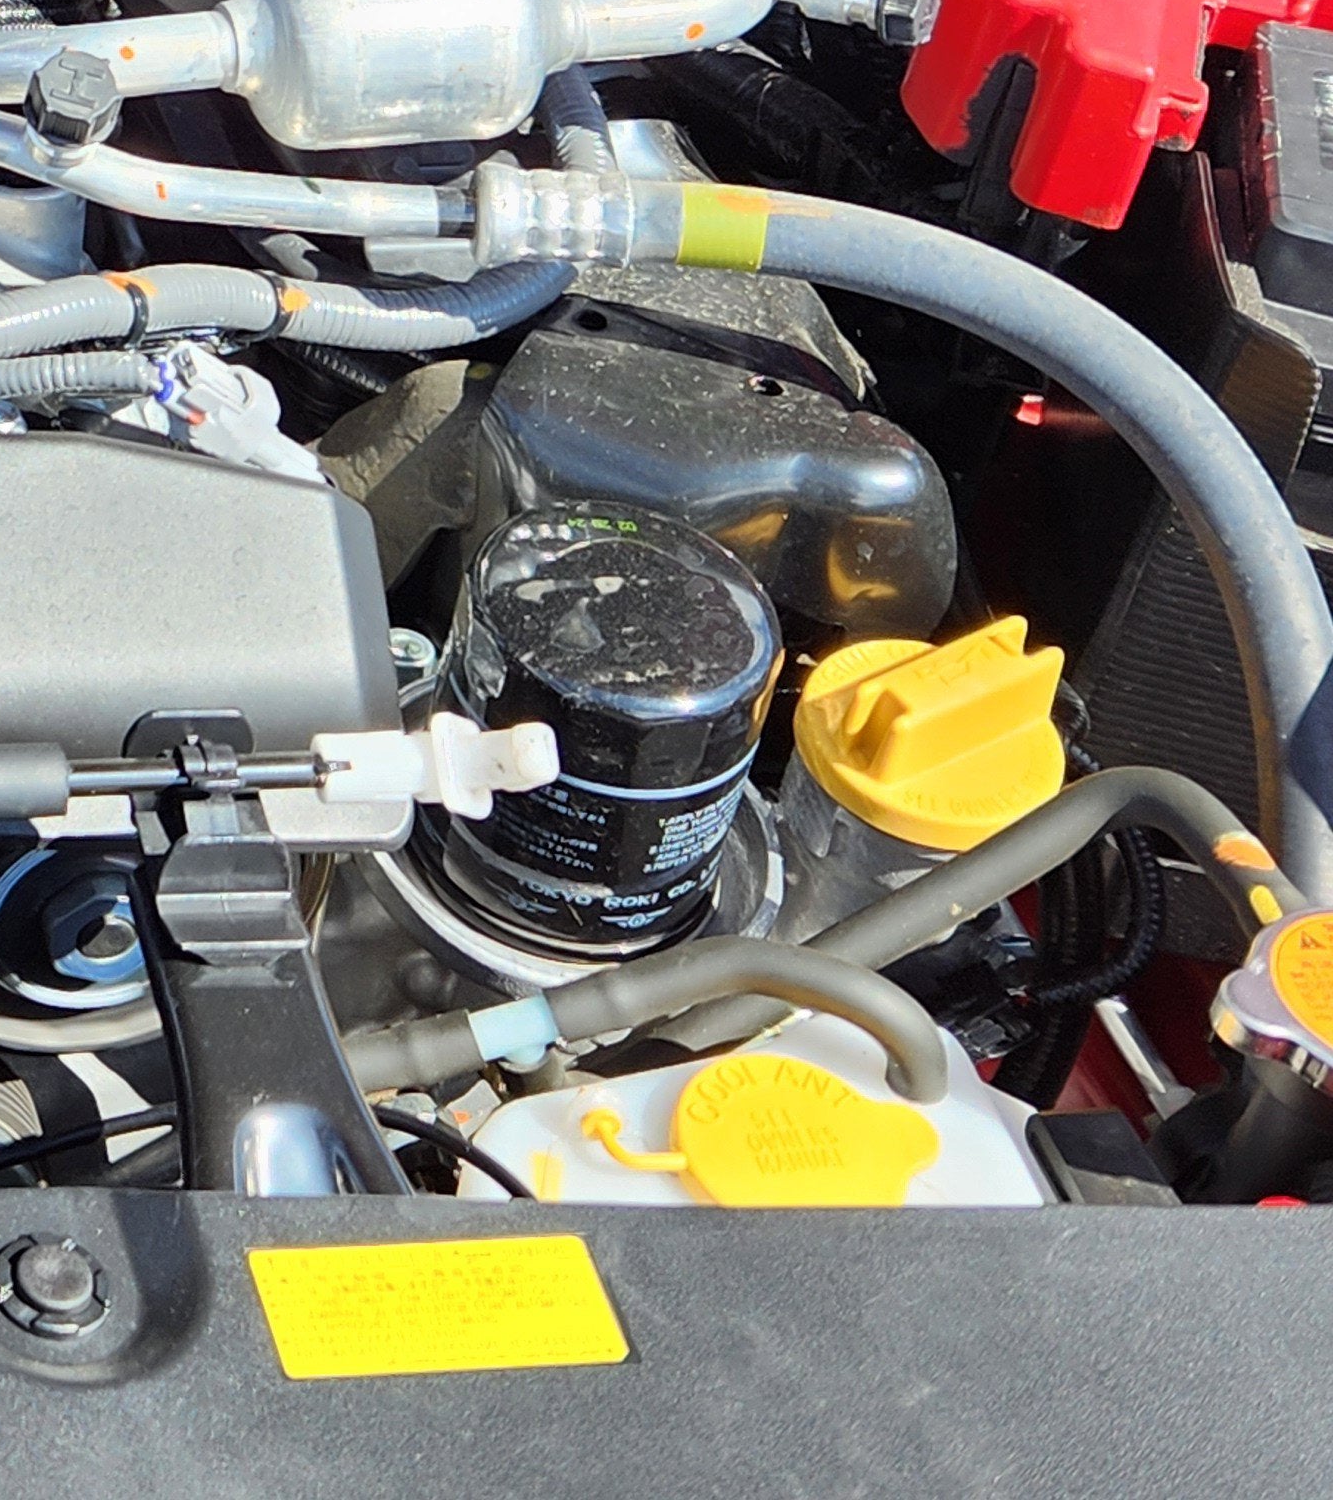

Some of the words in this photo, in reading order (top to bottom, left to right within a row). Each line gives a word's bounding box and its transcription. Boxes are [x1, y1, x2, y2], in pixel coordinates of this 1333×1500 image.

[48, 58, 105, 110] H
[518, 878, 593, 907] TOKYO
[603, 892, 660, 912] ROKI
[685, 1060, 860, 1125] COOLANT
